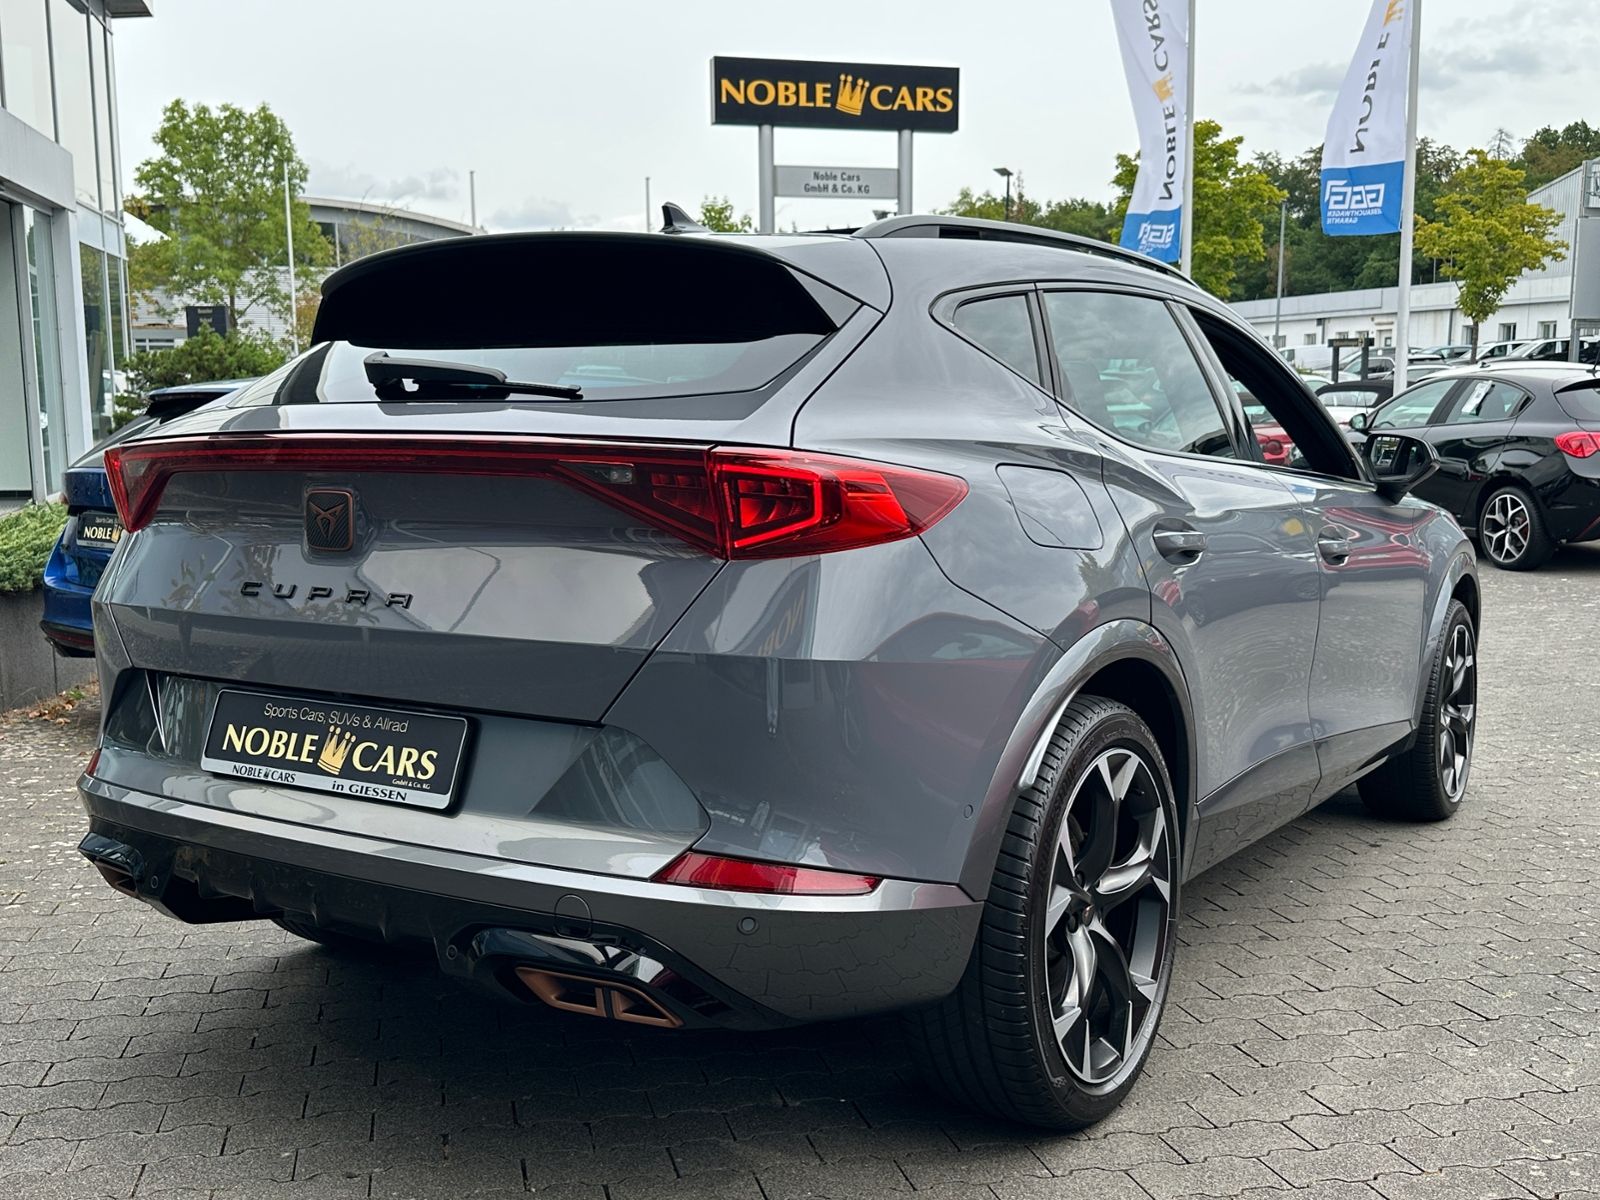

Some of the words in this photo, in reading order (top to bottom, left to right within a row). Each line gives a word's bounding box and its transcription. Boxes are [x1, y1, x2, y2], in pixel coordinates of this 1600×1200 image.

[720, 78, 832, 108] NOBLE
[869, 84, 954, 113] CARS
[813, 171, 838, 182] Noble
[840, 172, 861, 182] Cars
[803, 183, 829, 193] GmbH
[831, 184, 839, 193] &
[840, 184, 856, 194] Co.
[857, 184, 871, 194] KG
[83, 526, 113, 540] NOBLE
[240, 581, 414, 610] CUPRA
[264, 703, 299, 719] Sports
[299, 707, 327, 725] Cars,
[328, 711, 360, 728] SUVs
[362, 714, 372, 729] &
[373, 716, 409, 733] Allrad
[222, 723, 320, 763] NOBLE
[352, 740, 438, 780] CARS
[232, 764, 264, 778] NOBLE
[271, 769, 296, 784] CARS
[332, 780, 344, 792] in
[348, 783, 408, 802] GIESSEN
